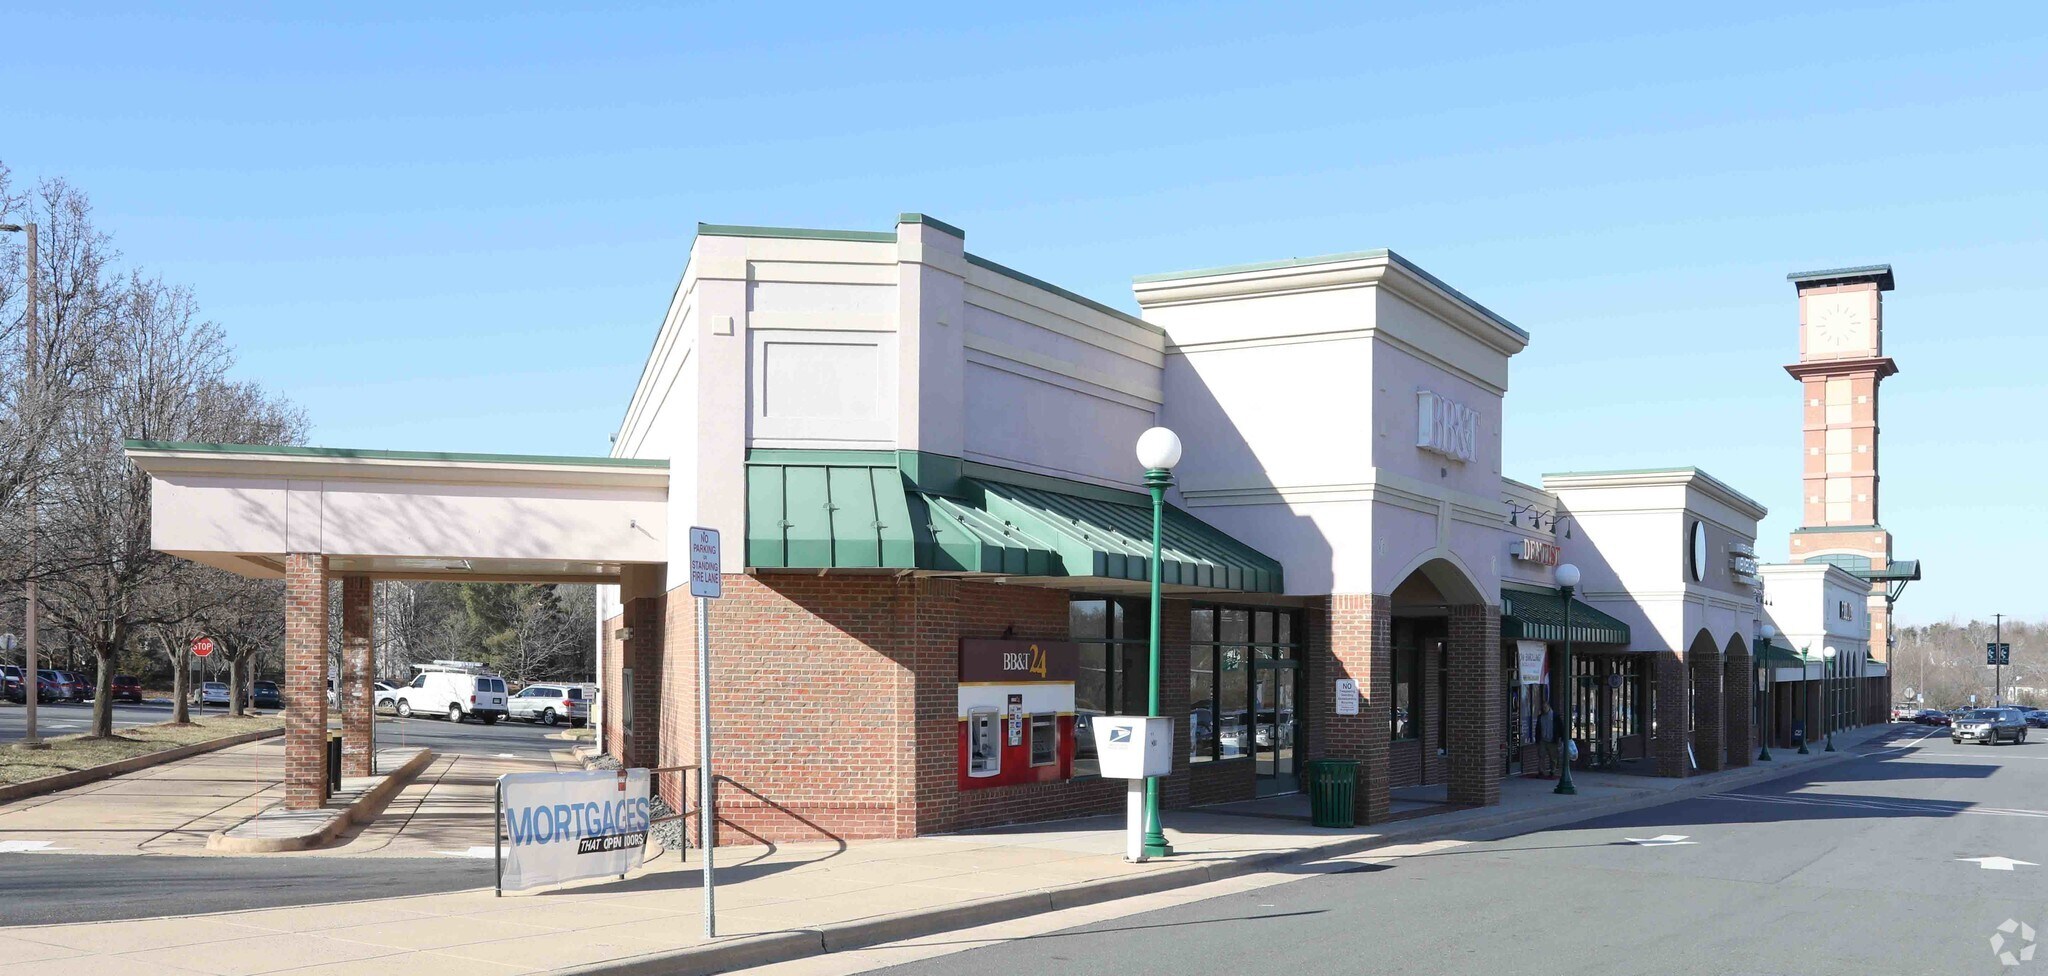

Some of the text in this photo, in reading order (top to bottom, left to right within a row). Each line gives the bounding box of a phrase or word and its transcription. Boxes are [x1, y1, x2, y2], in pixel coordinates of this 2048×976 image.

[1419, 391, 1481, 464] BB&T
[700, 534, 709, 544] NO
[693, 544, 717, 555] PARKING
[1523, 538, 1561, 567] DENTIST
[692, 560, 719, 572] STANDING
[692, 571, 719, 584] FIRE LANE
[192, 642, 212, 651] STOP
[1003, 644, 1047, 679] BB&T 24
[1342, 682, 1352, 690] NO
[507, 797, 649, 847] MORTGAGES
[580, 838, 602, 852] THAT
[603, 836, 622, 849] OPEN
